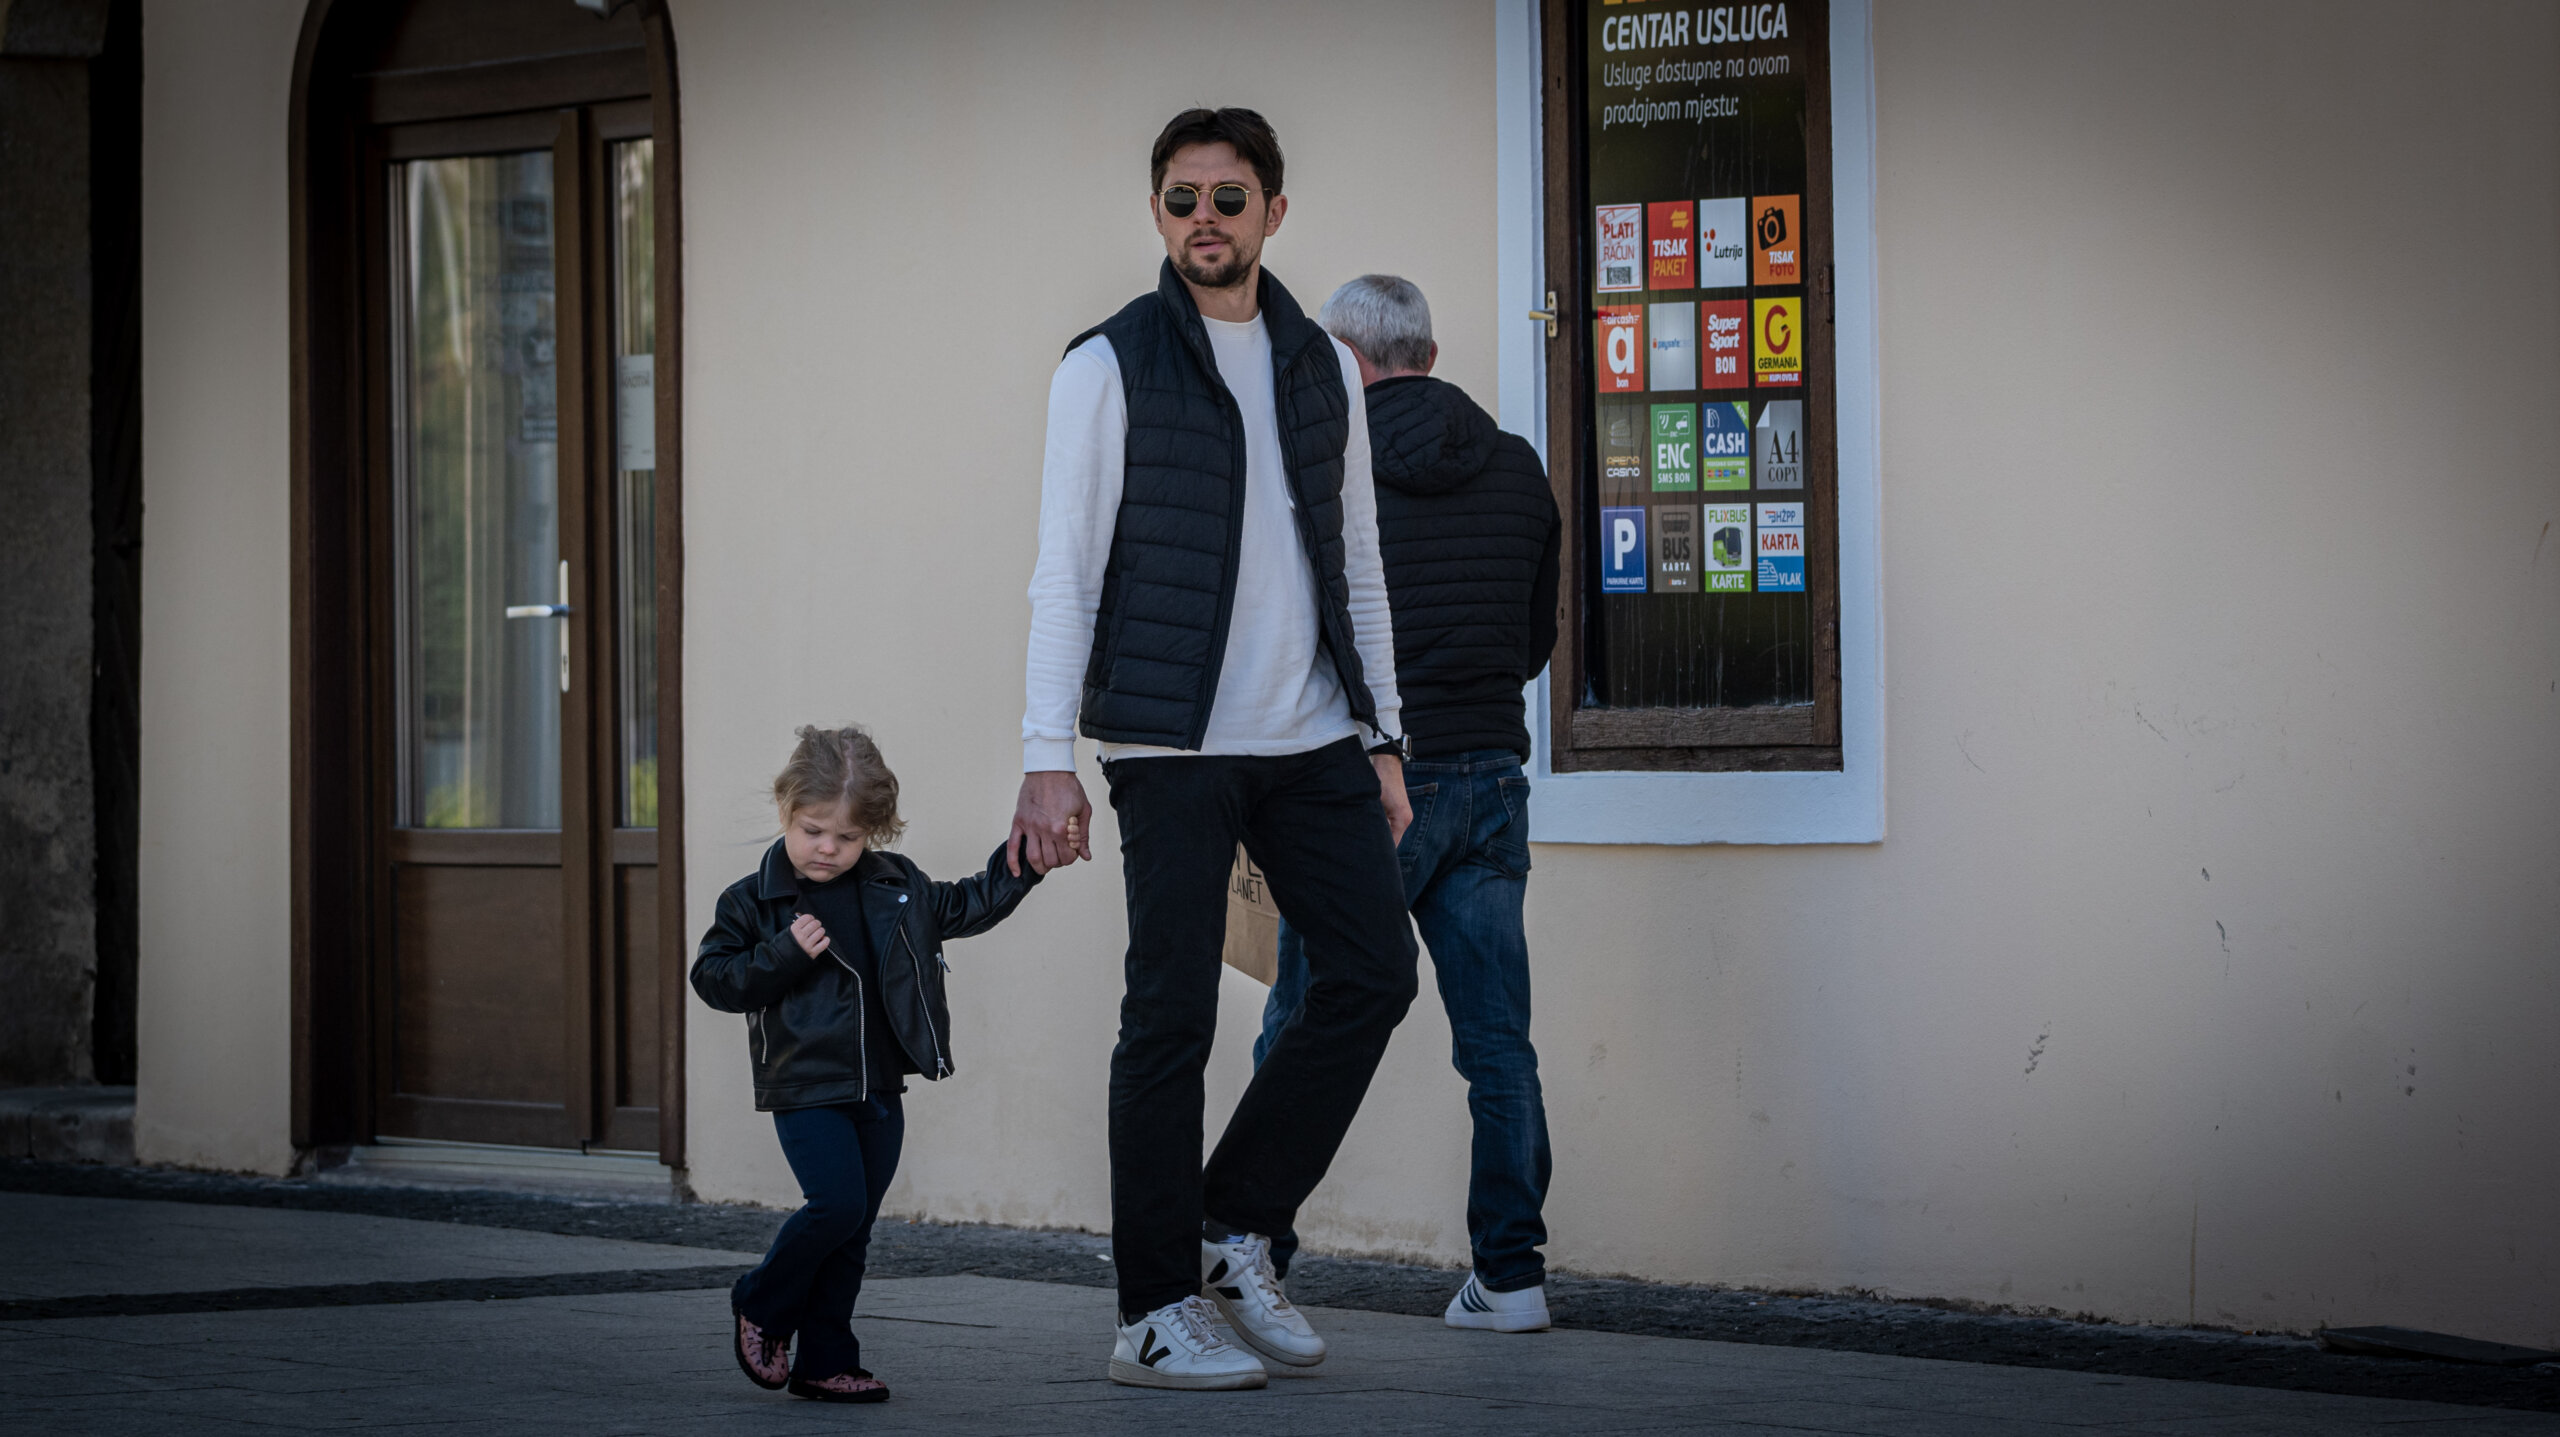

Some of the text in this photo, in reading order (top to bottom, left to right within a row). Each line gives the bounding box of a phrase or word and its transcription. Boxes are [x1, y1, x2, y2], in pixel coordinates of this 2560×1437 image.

[1602, 3, 1788, 52] CENTAR USLUGA
[1603, 54, 1789, 92] Usluge dostupne na ovom
[1603, 93, 1739, 130] prodajnom mjestu:
[1603, 223, 1634, 239] PLATI
[1603, 242, 1635, 261] RAČUN
[1652, 238, 1688, 257] TISAK
[1714, 243, 1743, 261] Lutrija
[1768, 250, 1795, 264] TISAK
[1653, 258, 1688, 277] PAKET
[1769, 263, 1795, 277] FOTO
[1707, 314, 1741, 332] Super
[1709, 332, 1740, 352] Sport
[1715, 356, 1736, 374] BON
[1757, 356, 1798, 370] GERMANIA
[1616, 377, 1629, 388] bon
[1705, 432, 1746, 455] CASH
[1768, 430, 1799, 464] A4
[1657, 443, 1690, 470] ENC
[1657, 471, 1690, 484] SMS BON
[1768, 466, 1799, 482] COPY
[1614, 518, 1637, 571] P
[1662, 536, 1690, 560] BUS
[1762, 533, 1800, 551] KARTA
[1662, 561, 1691, 573] KARTA
[1711, 573, 1746, 589] KARTE
[1779, 572, 1802, 586] VLAK
[1230, 873, 1263, 905] LANET
